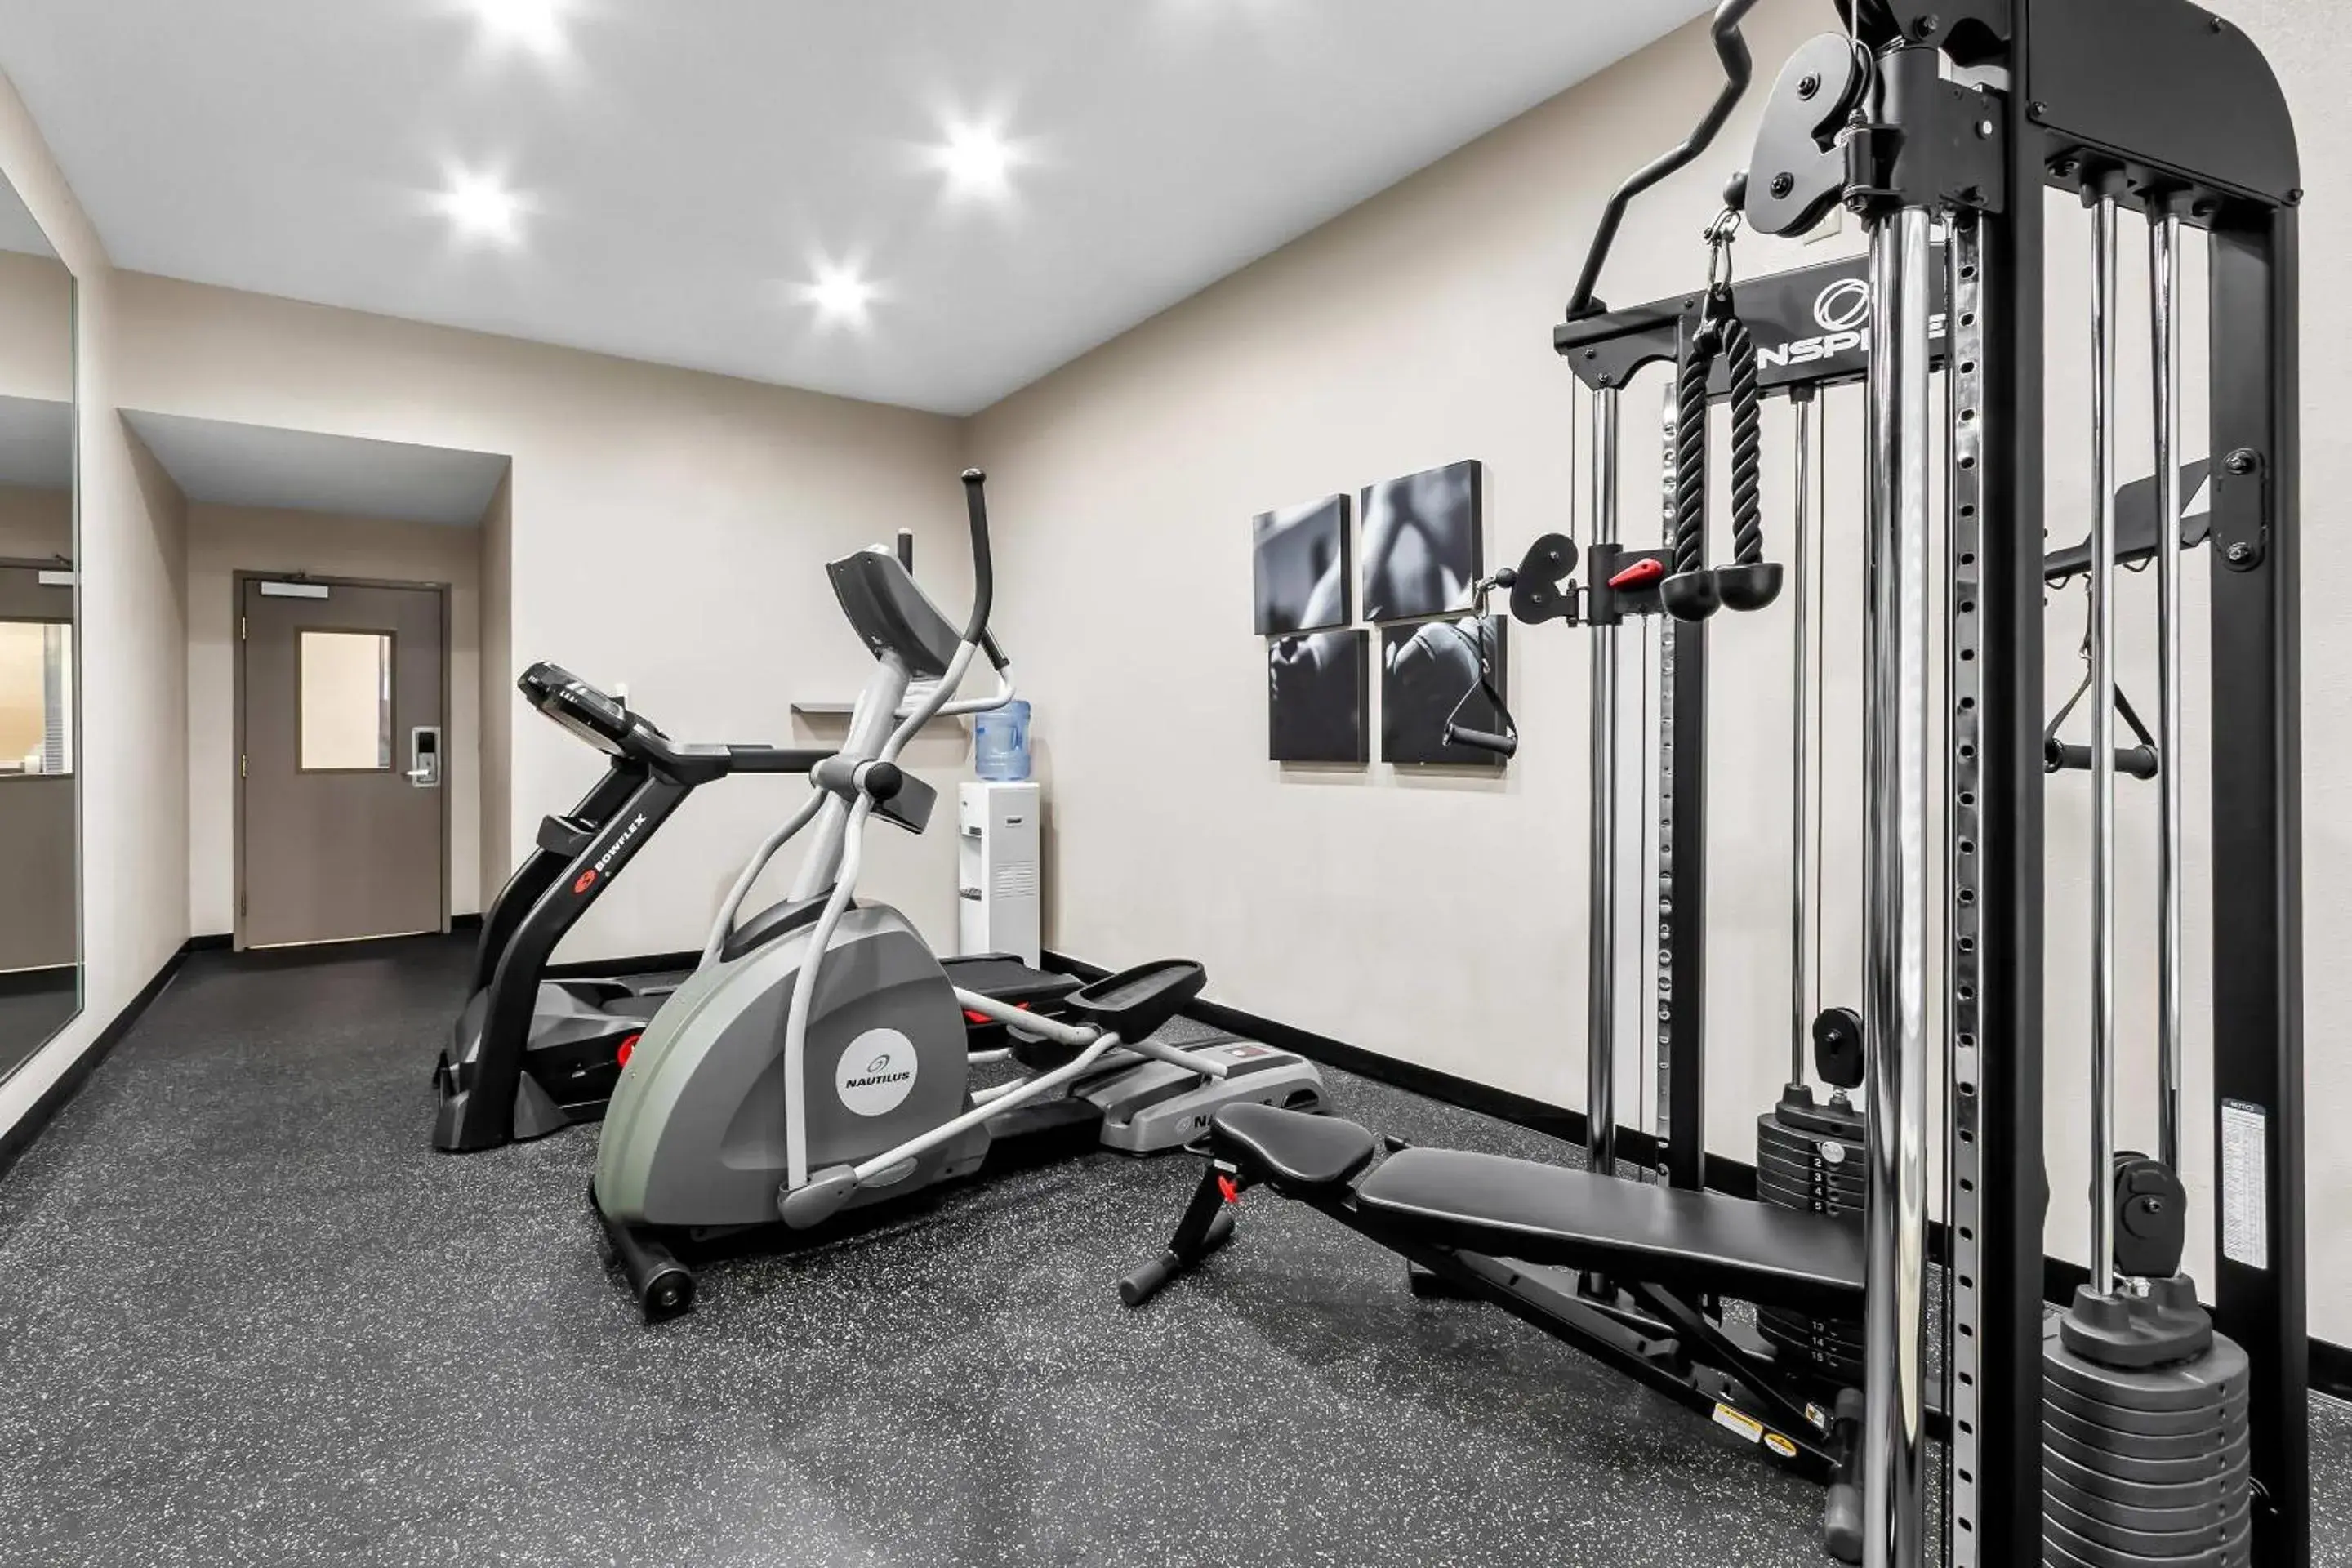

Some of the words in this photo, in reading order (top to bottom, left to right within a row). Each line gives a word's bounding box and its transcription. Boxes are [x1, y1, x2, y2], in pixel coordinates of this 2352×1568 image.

[1757, 313, 1946, 370] NSPIE
[594, 813, 647, 872] BOWFLEX
[845, 1071, 910, 1089] NAUTILUS
[1814, 1158, 1822, 1168] 2
[1815, 1172, 1822, 1182] 3
[1815, 1187, 1823, 1196] 4
[1815, 1201, 1822, 1210] 5
[1812, 1336, 1824, 1347] 14
